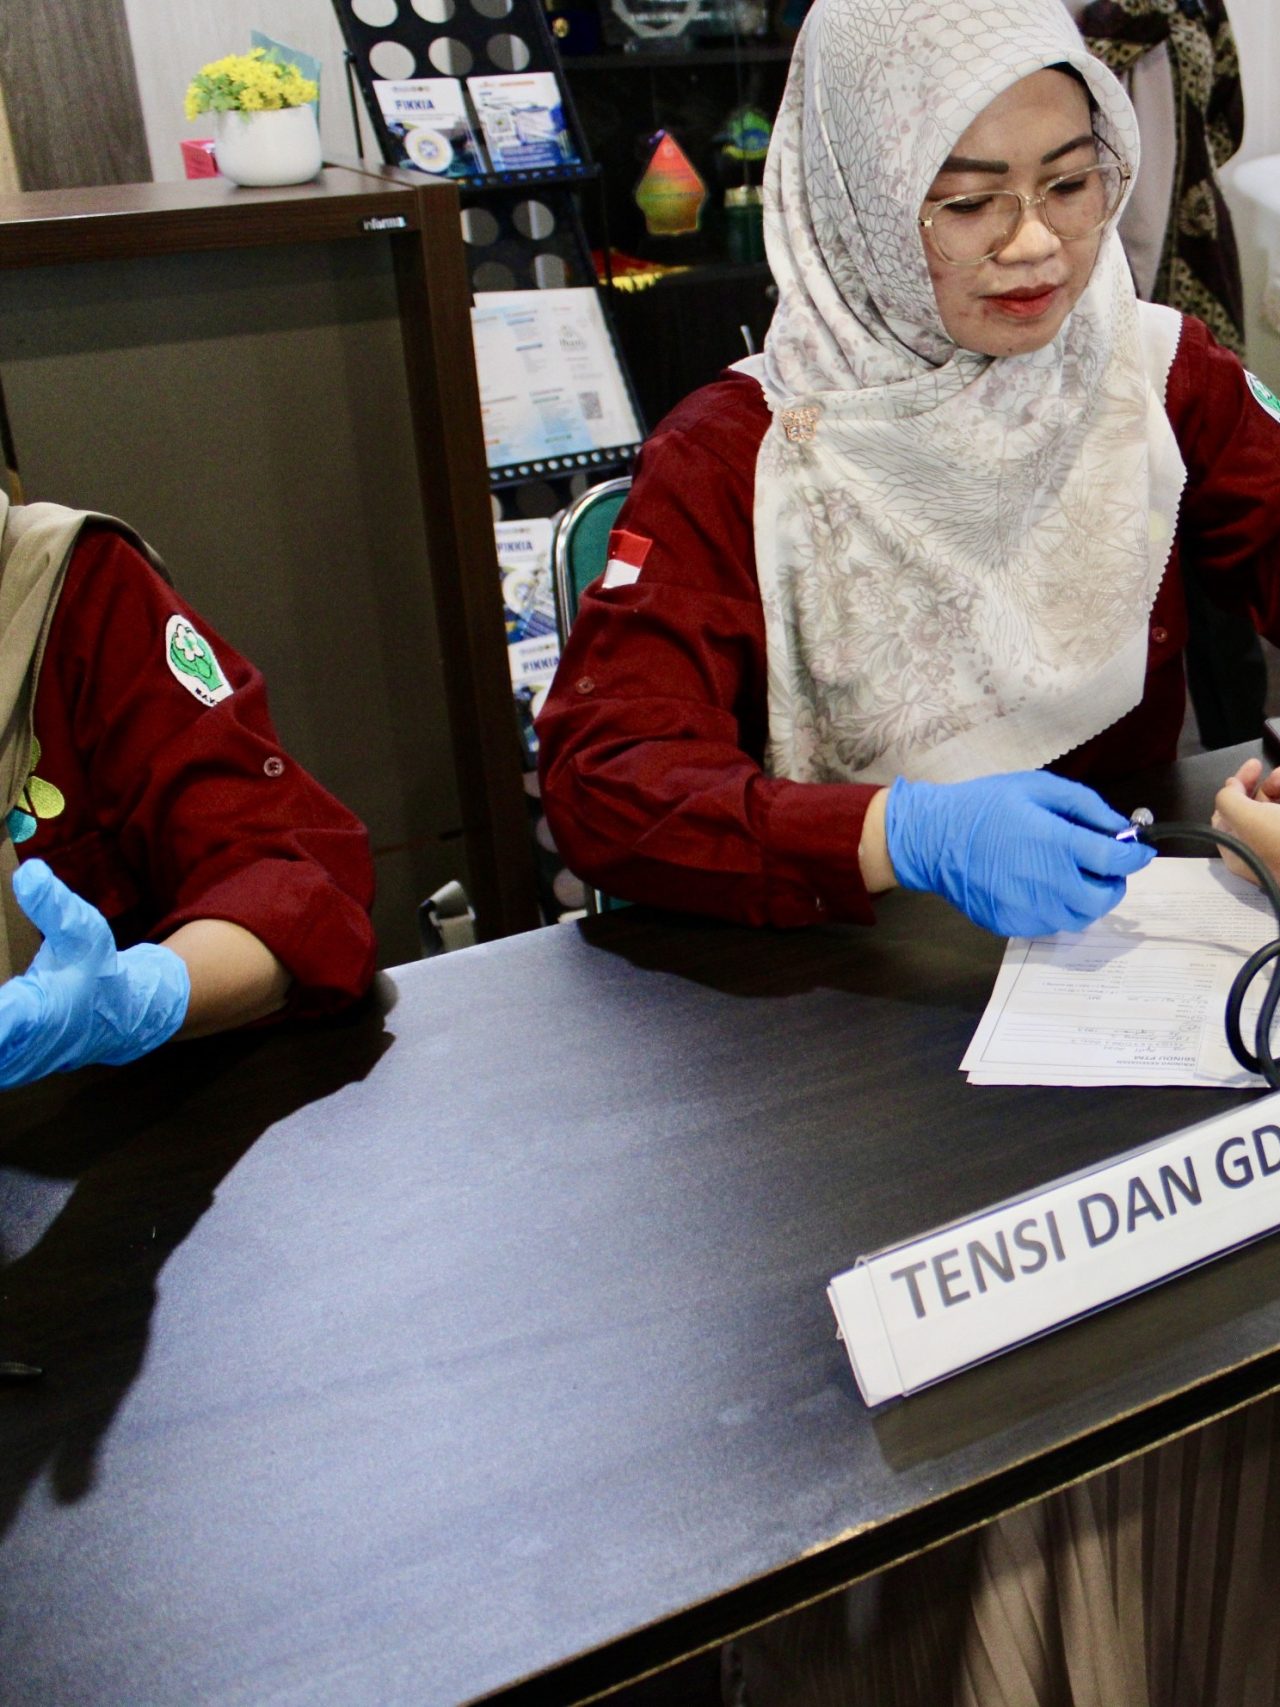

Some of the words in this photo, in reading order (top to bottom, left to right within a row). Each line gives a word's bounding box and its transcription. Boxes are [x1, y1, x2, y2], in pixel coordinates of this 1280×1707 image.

[395, 99, 434, 110] FIKKIA
[890, 1210, 1067, 1319] TENSI
[1078, 1156, 1203, 1248] DAN
